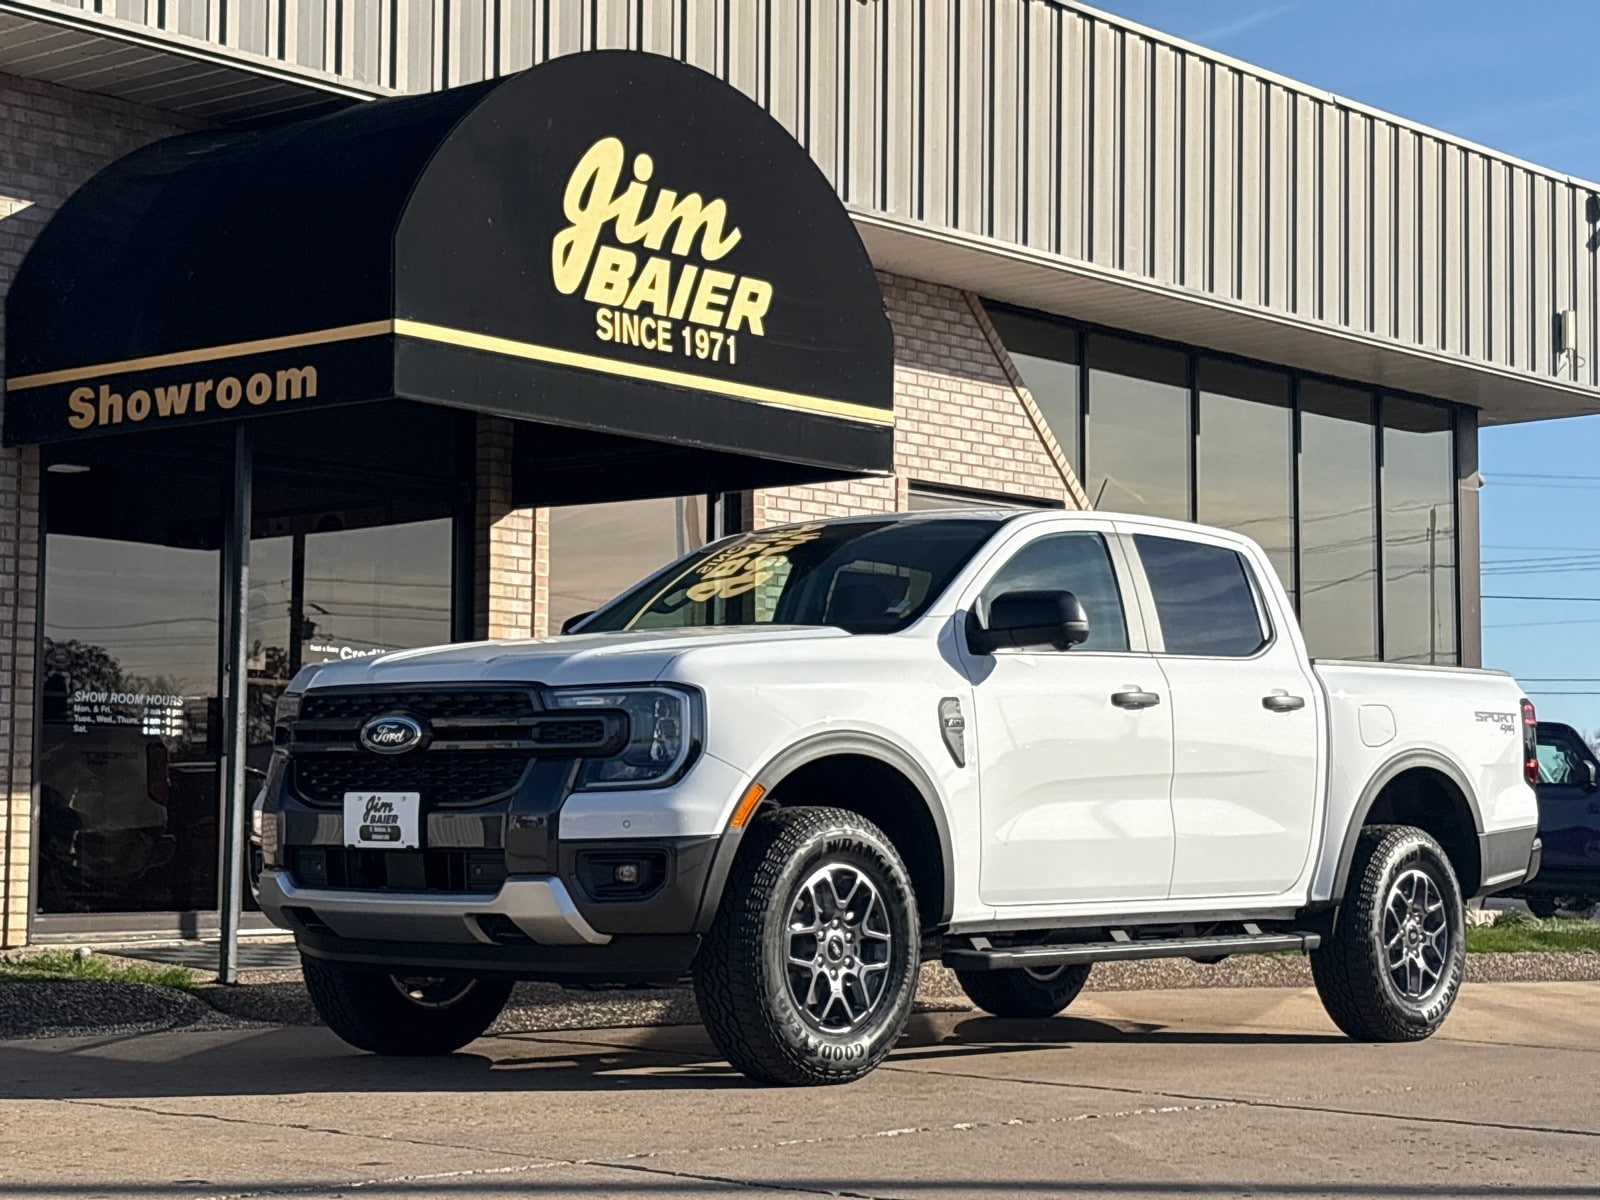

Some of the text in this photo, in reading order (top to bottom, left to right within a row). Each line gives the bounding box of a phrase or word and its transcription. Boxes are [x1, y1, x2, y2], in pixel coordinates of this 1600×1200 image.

[552, 137, 742, 294] Jim
[584, 245, 773, 336] BAIER
[596, 308, 736, 365] SINCE 1971
[68, 365, 317, 429] Showroom
[340, 646, 386, 660] Cred
[74, 691, 183, 706] SHOW ROOM HOURS
[1474, 711, 1517, 723] SPORT
[372, 724, 406, 743] Ford
[362, 795, 394, 823] Jim
[370, 814, 399, 824] BAIER
